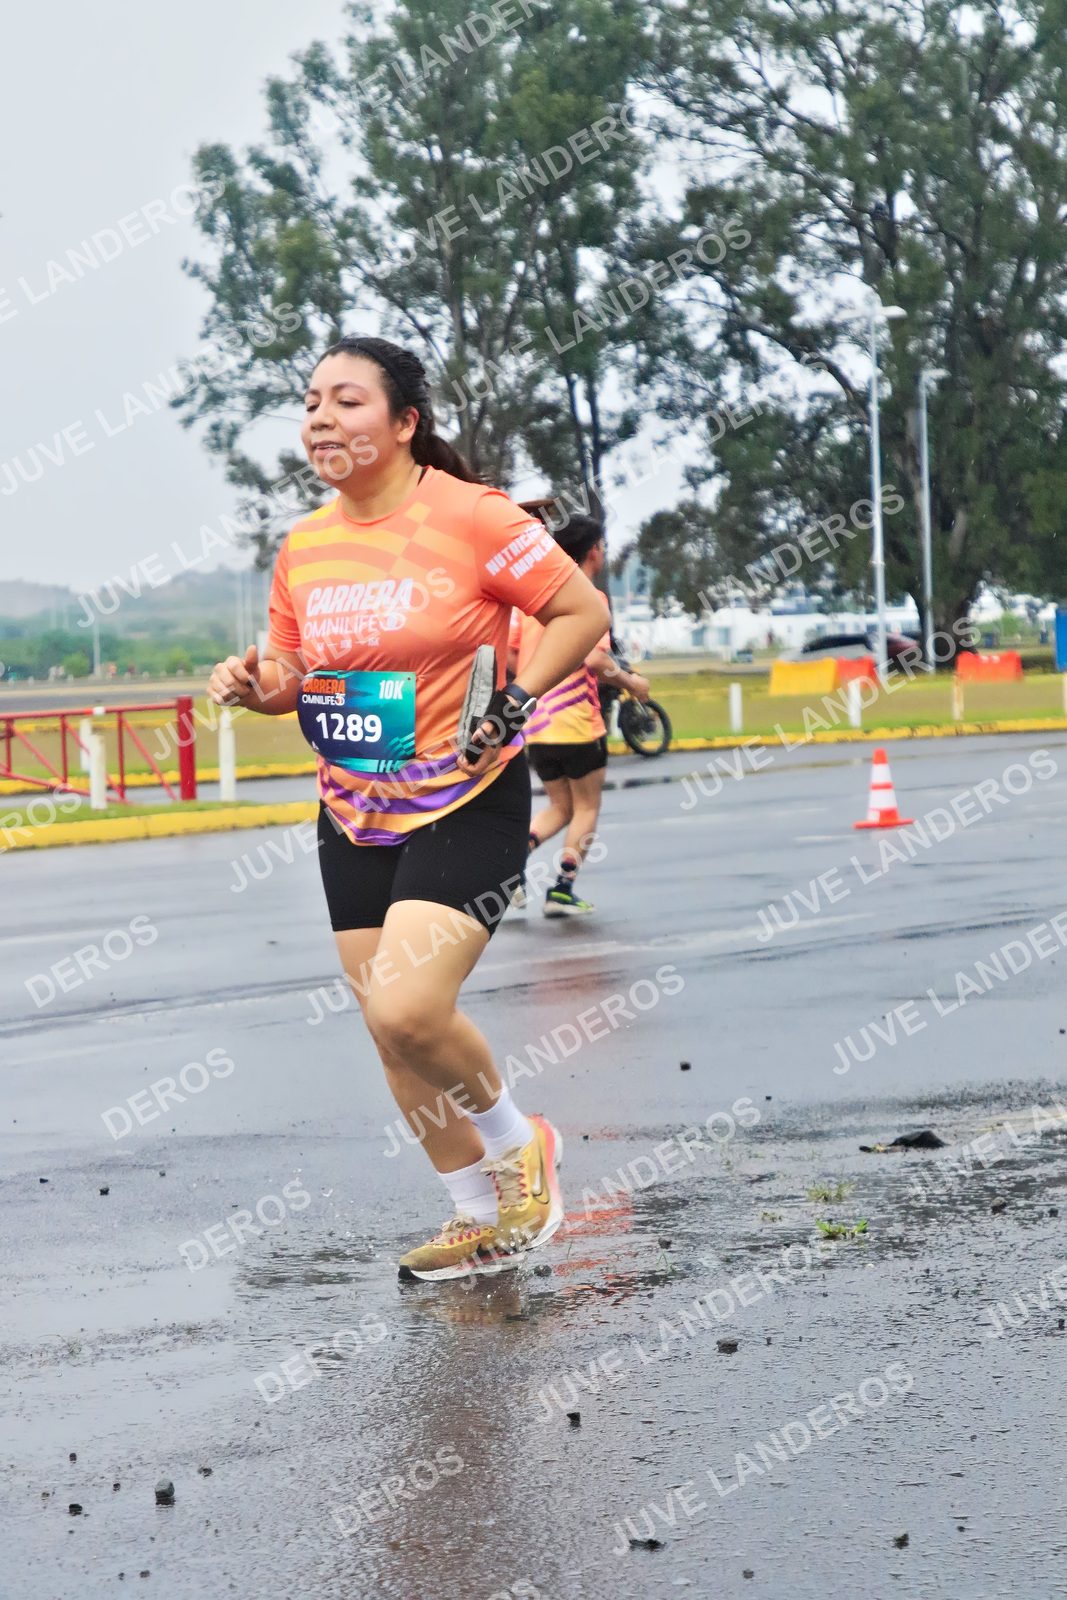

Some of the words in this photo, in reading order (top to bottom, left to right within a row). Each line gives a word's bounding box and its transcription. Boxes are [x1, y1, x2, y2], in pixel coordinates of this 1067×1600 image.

[306, 577, 414, 618] CARRERA
[302, 678, 345, 694] CARRERA
[379, 680, 405, 700] 10K
[316, 712, 383, 743] 1289
